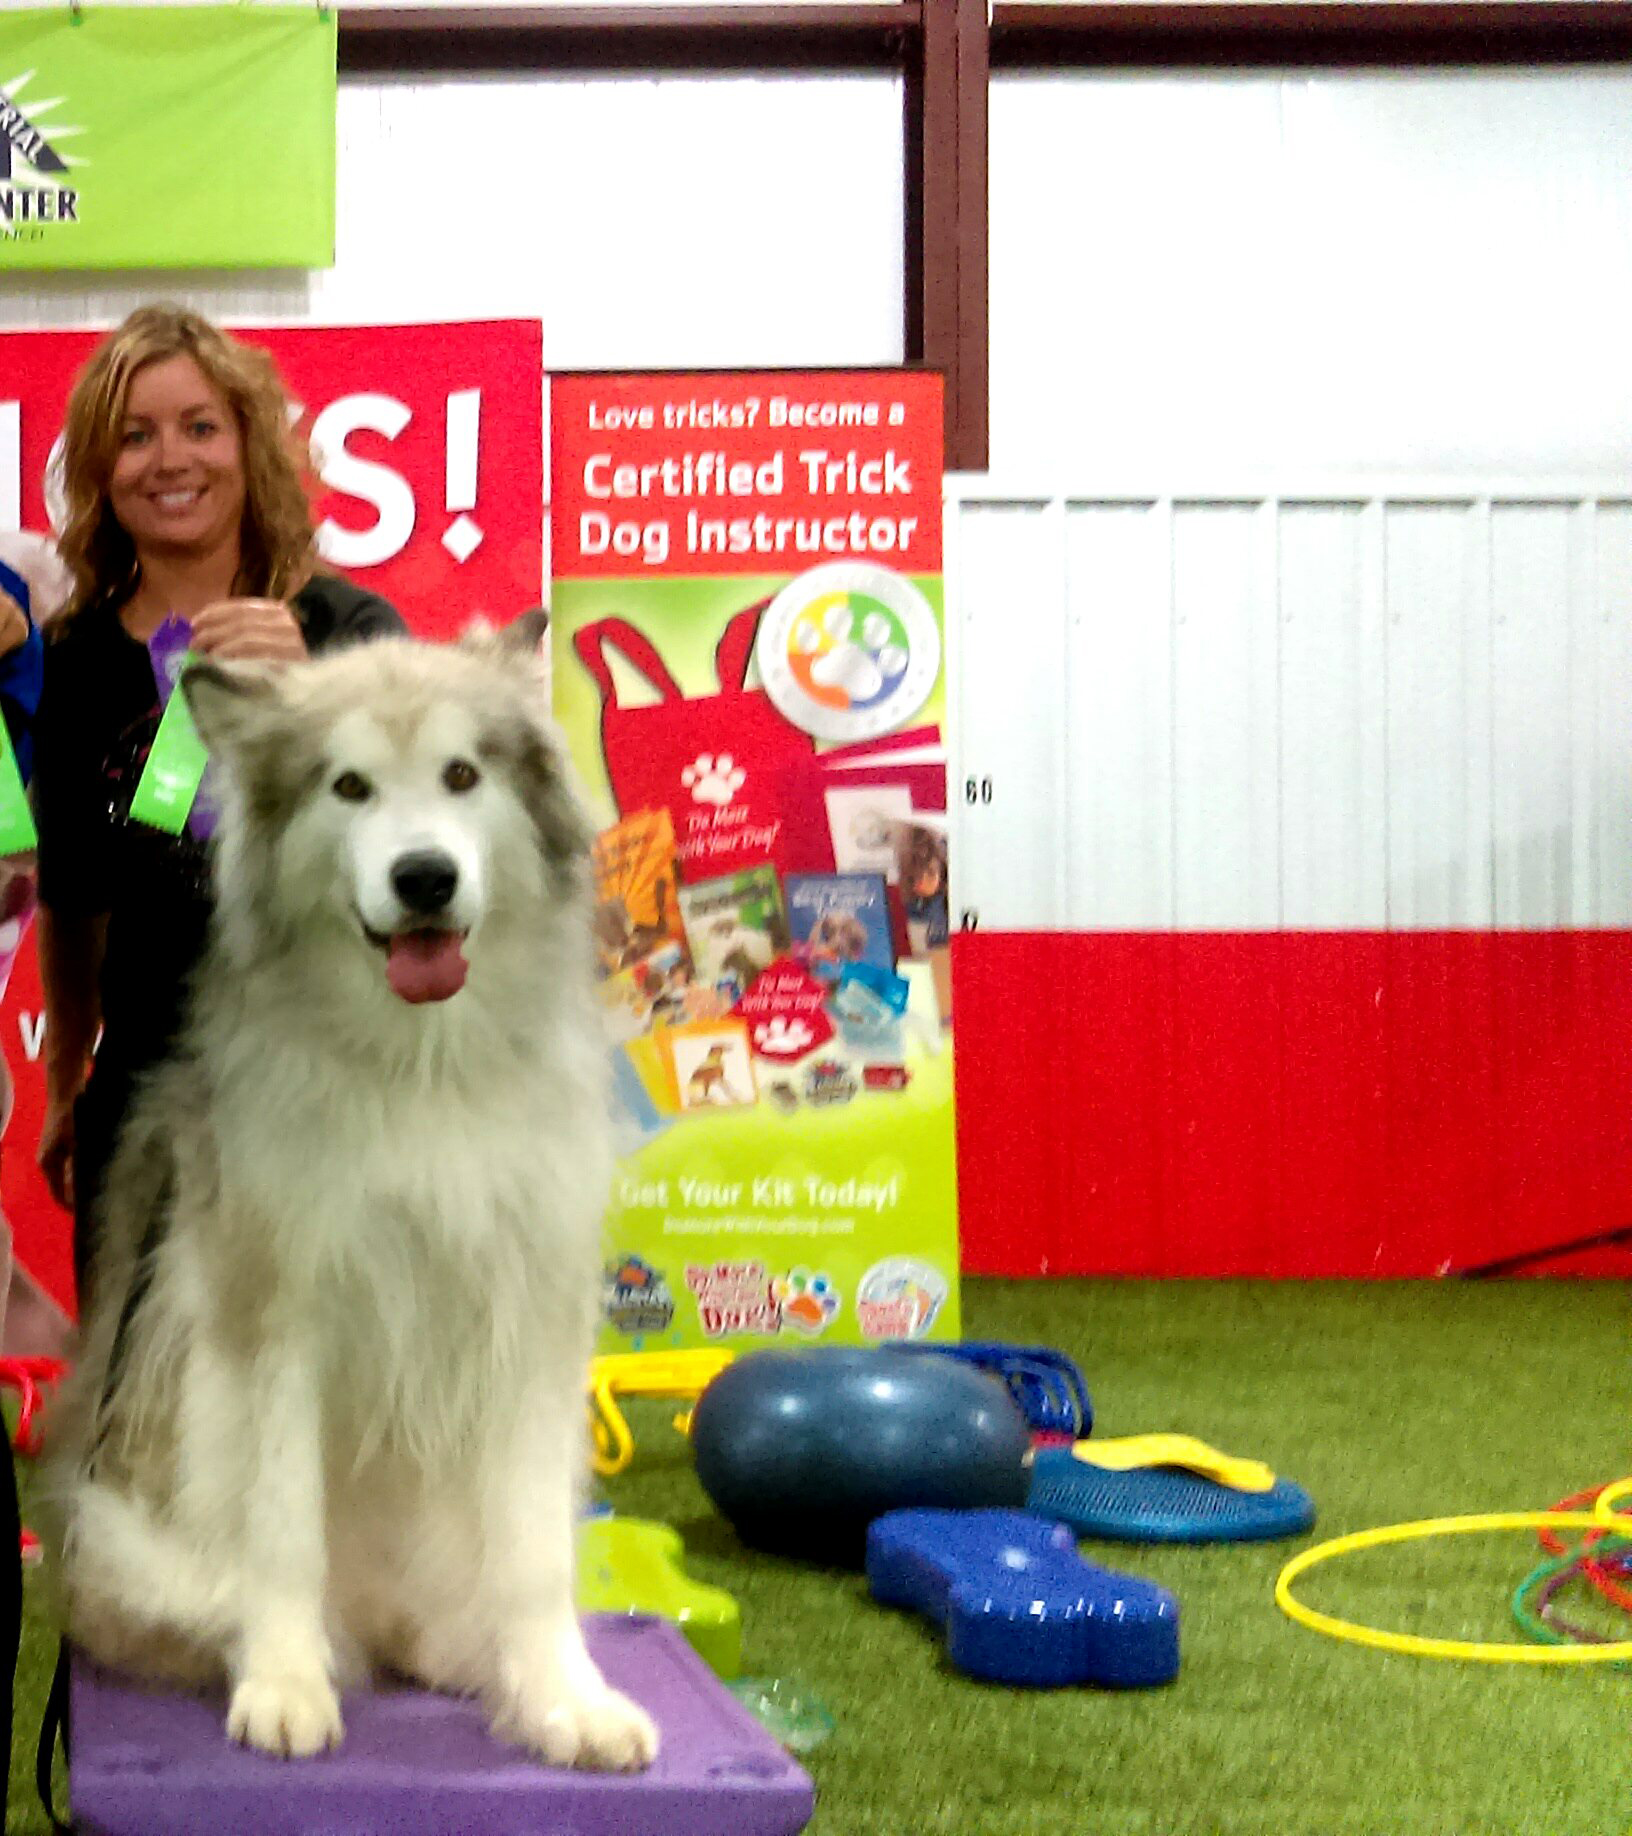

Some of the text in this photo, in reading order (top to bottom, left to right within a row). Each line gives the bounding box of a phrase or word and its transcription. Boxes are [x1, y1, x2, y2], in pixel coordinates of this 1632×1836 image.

[588, 397, 906, 431] Love tricks? Become a
[583, 447, 913, 498] Certified Trick
[579, 508, 919, 564] Dog Instructor
[966, 775, 993, 805] 60
[678, 1176, 743, 1207] Your
[804, 1174, 898, 1214] Today!
